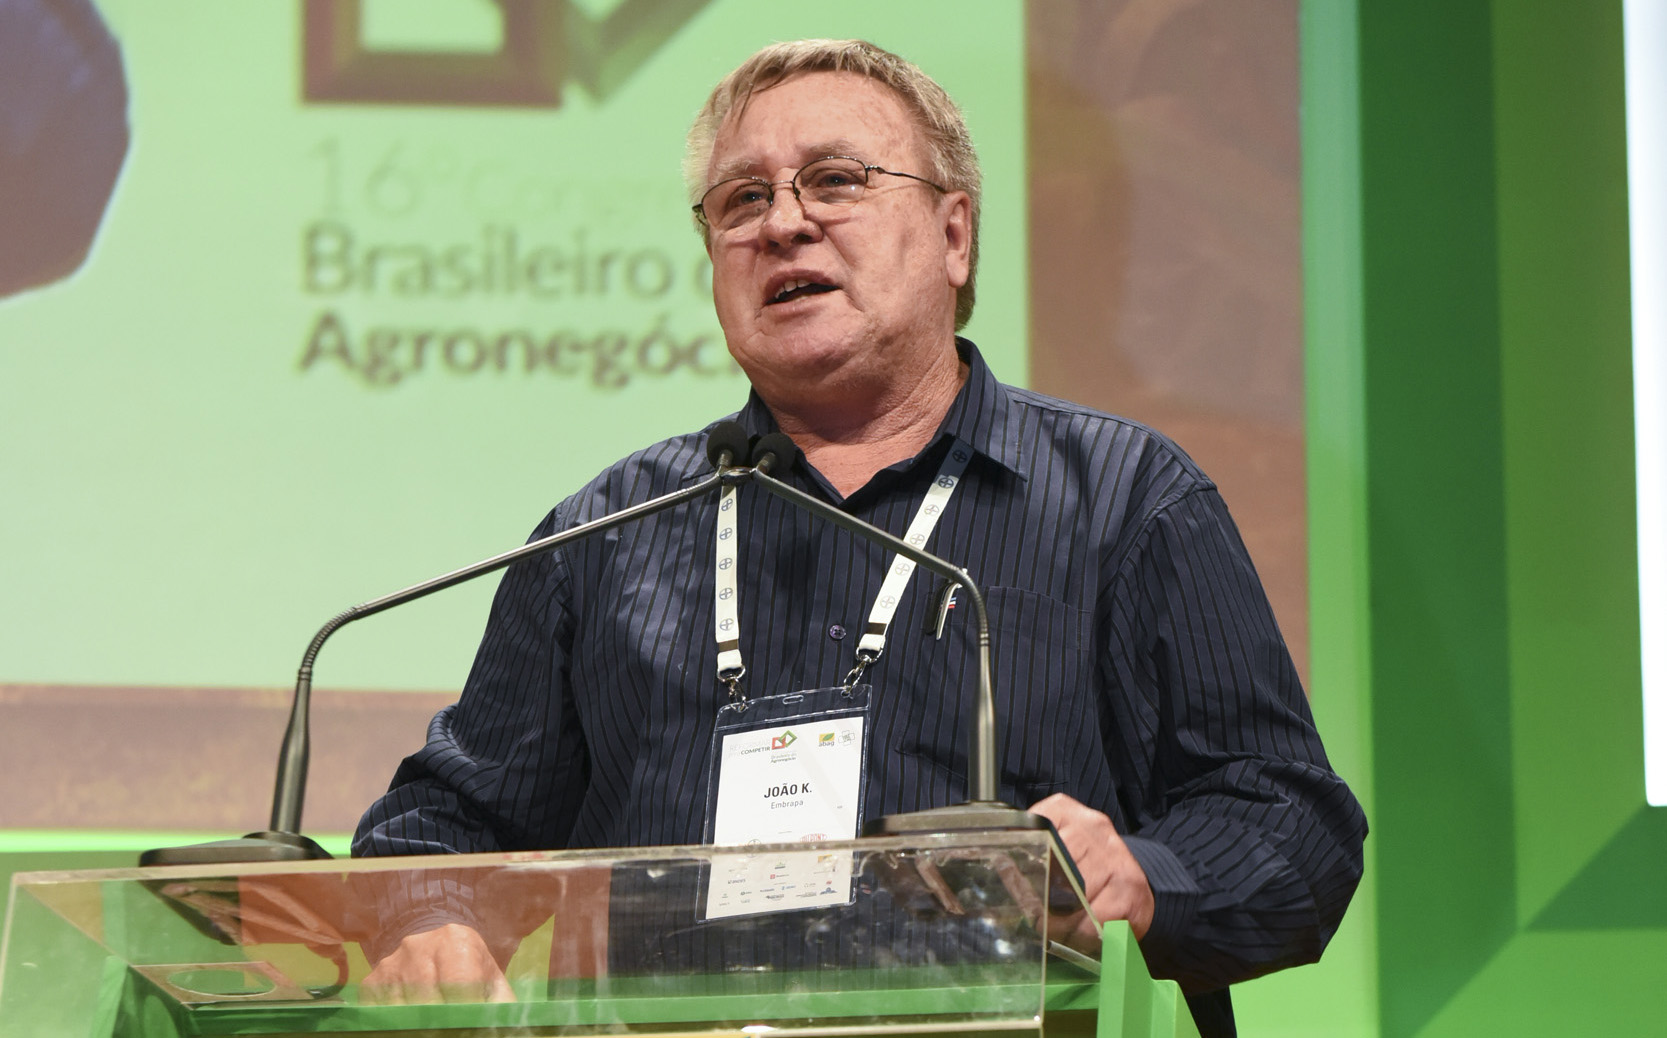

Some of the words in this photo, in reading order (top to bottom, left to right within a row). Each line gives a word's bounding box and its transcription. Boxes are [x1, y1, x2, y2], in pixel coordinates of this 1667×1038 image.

[301, 222, 675, 298] Brasileiro
[740, 746, 771, 756] COMPETIR
[763, 783, 798, 799] JOÃO
[801, 783, 813, 795] K.
[770, 800, 804, 810] Embrapa
